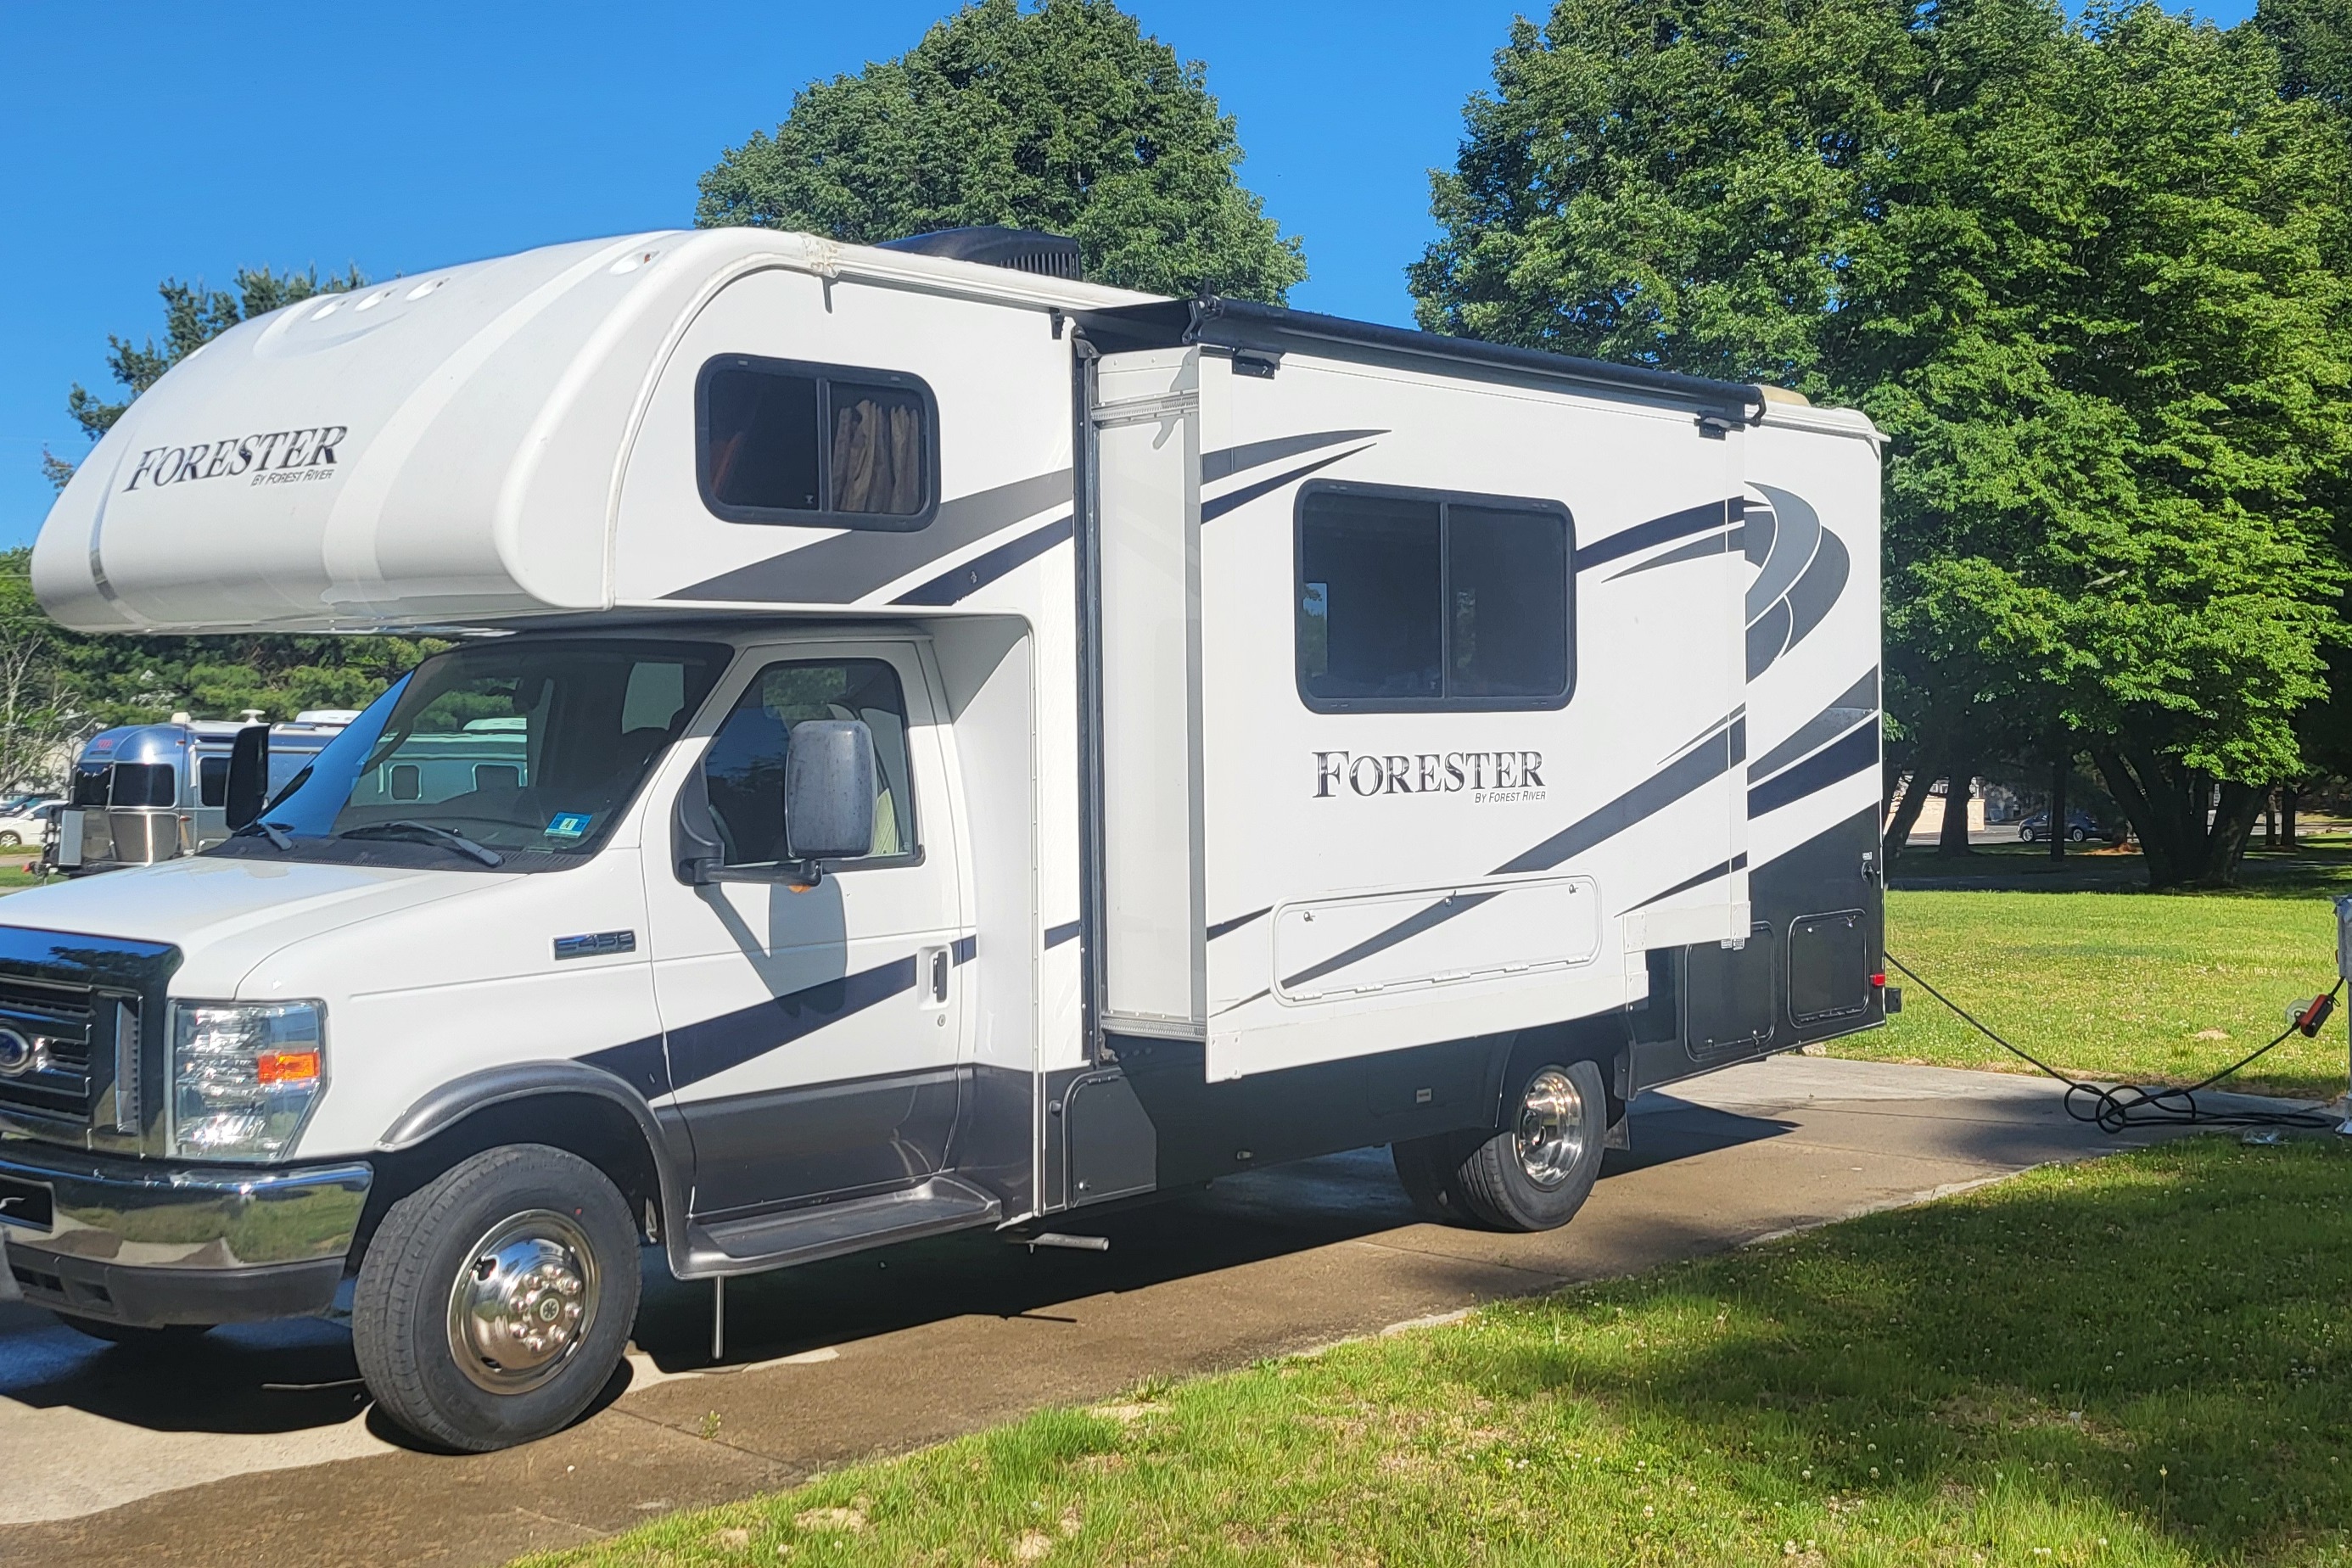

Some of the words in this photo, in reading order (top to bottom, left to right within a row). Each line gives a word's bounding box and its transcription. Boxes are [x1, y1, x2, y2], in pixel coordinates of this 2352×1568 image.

[121, 426, 348, 493] FORESTER
[250, 473, 267, 486] BY
[266, 471, 305, 484] FOREST
[302, 468, 334, 482] RIVER
[1312, 750, 1546, 798] FORESTER
[1475, 792, 1487, 804] BY
[1489, 792, 1520, 803] FOREST
[1522, 791, 1546, 801] RIVER
